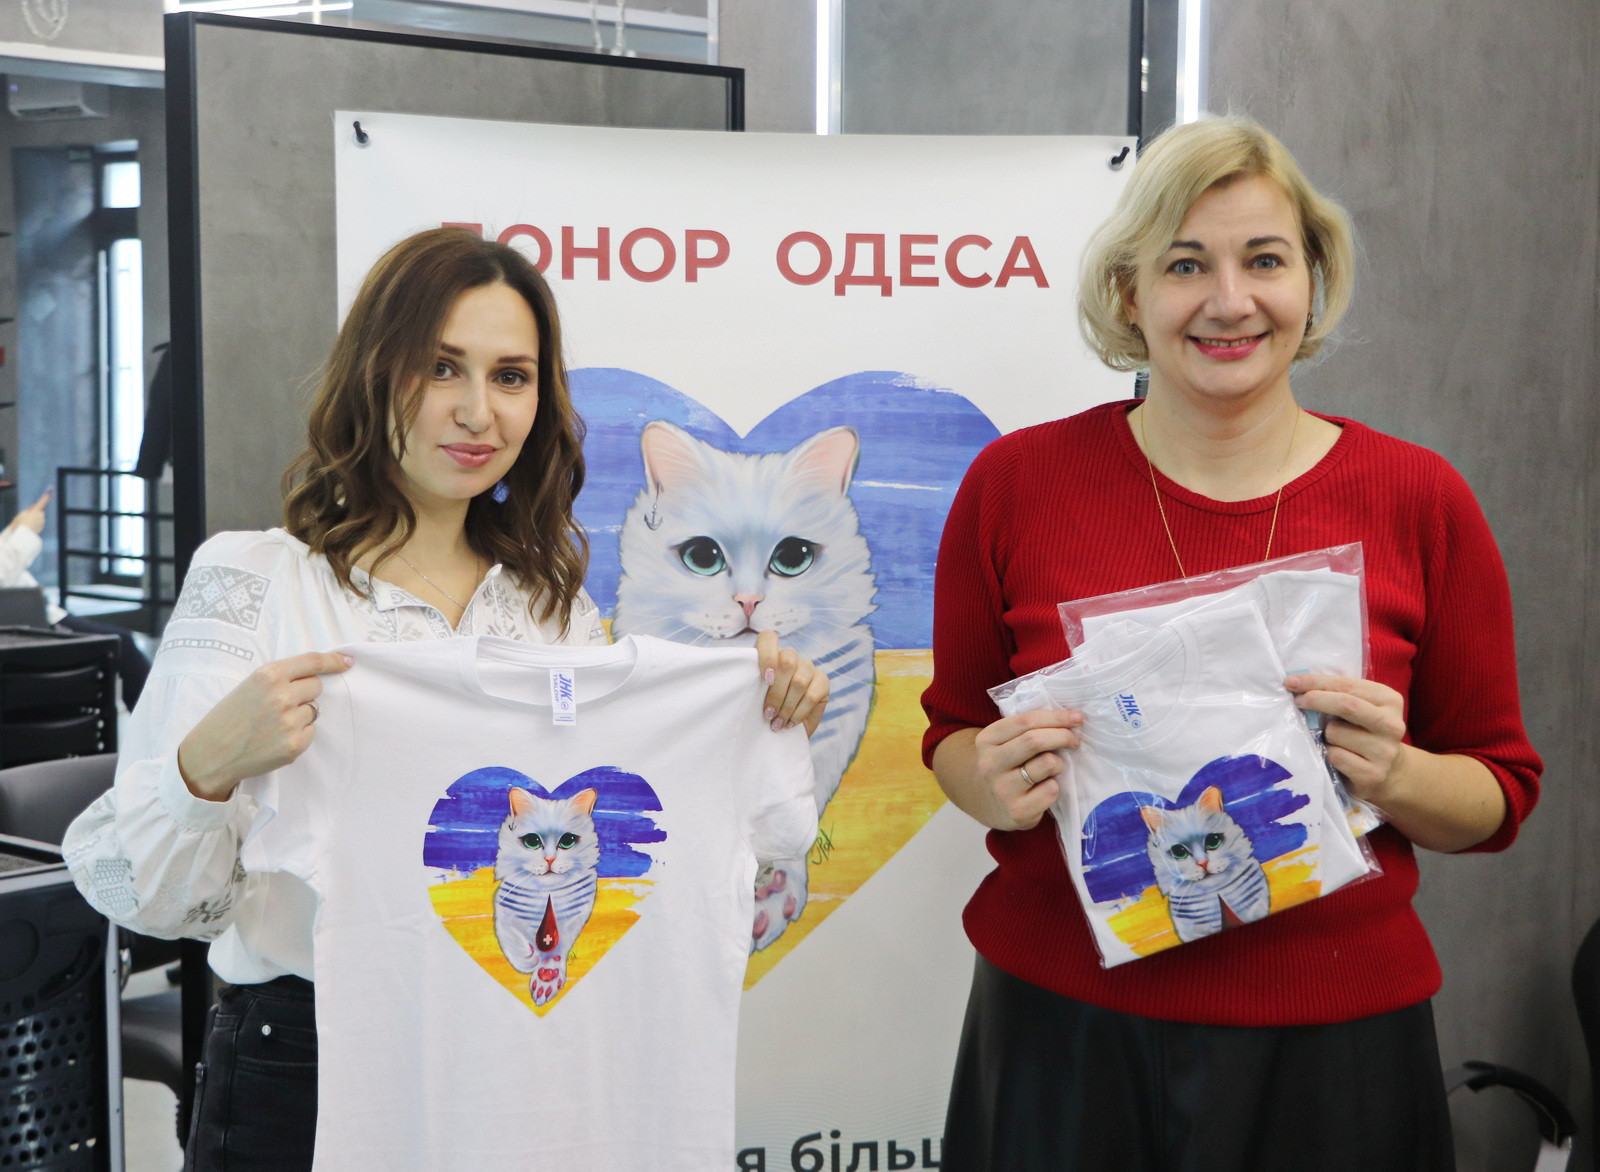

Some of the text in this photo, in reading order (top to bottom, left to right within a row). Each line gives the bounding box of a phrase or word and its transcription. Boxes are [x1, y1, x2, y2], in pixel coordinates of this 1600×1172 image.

[441, 221, 1050, 297] ОНОР ОДЕСА
[559, 673, 573, 702] JHK
[1119, 693, 1142, 716] JHK
